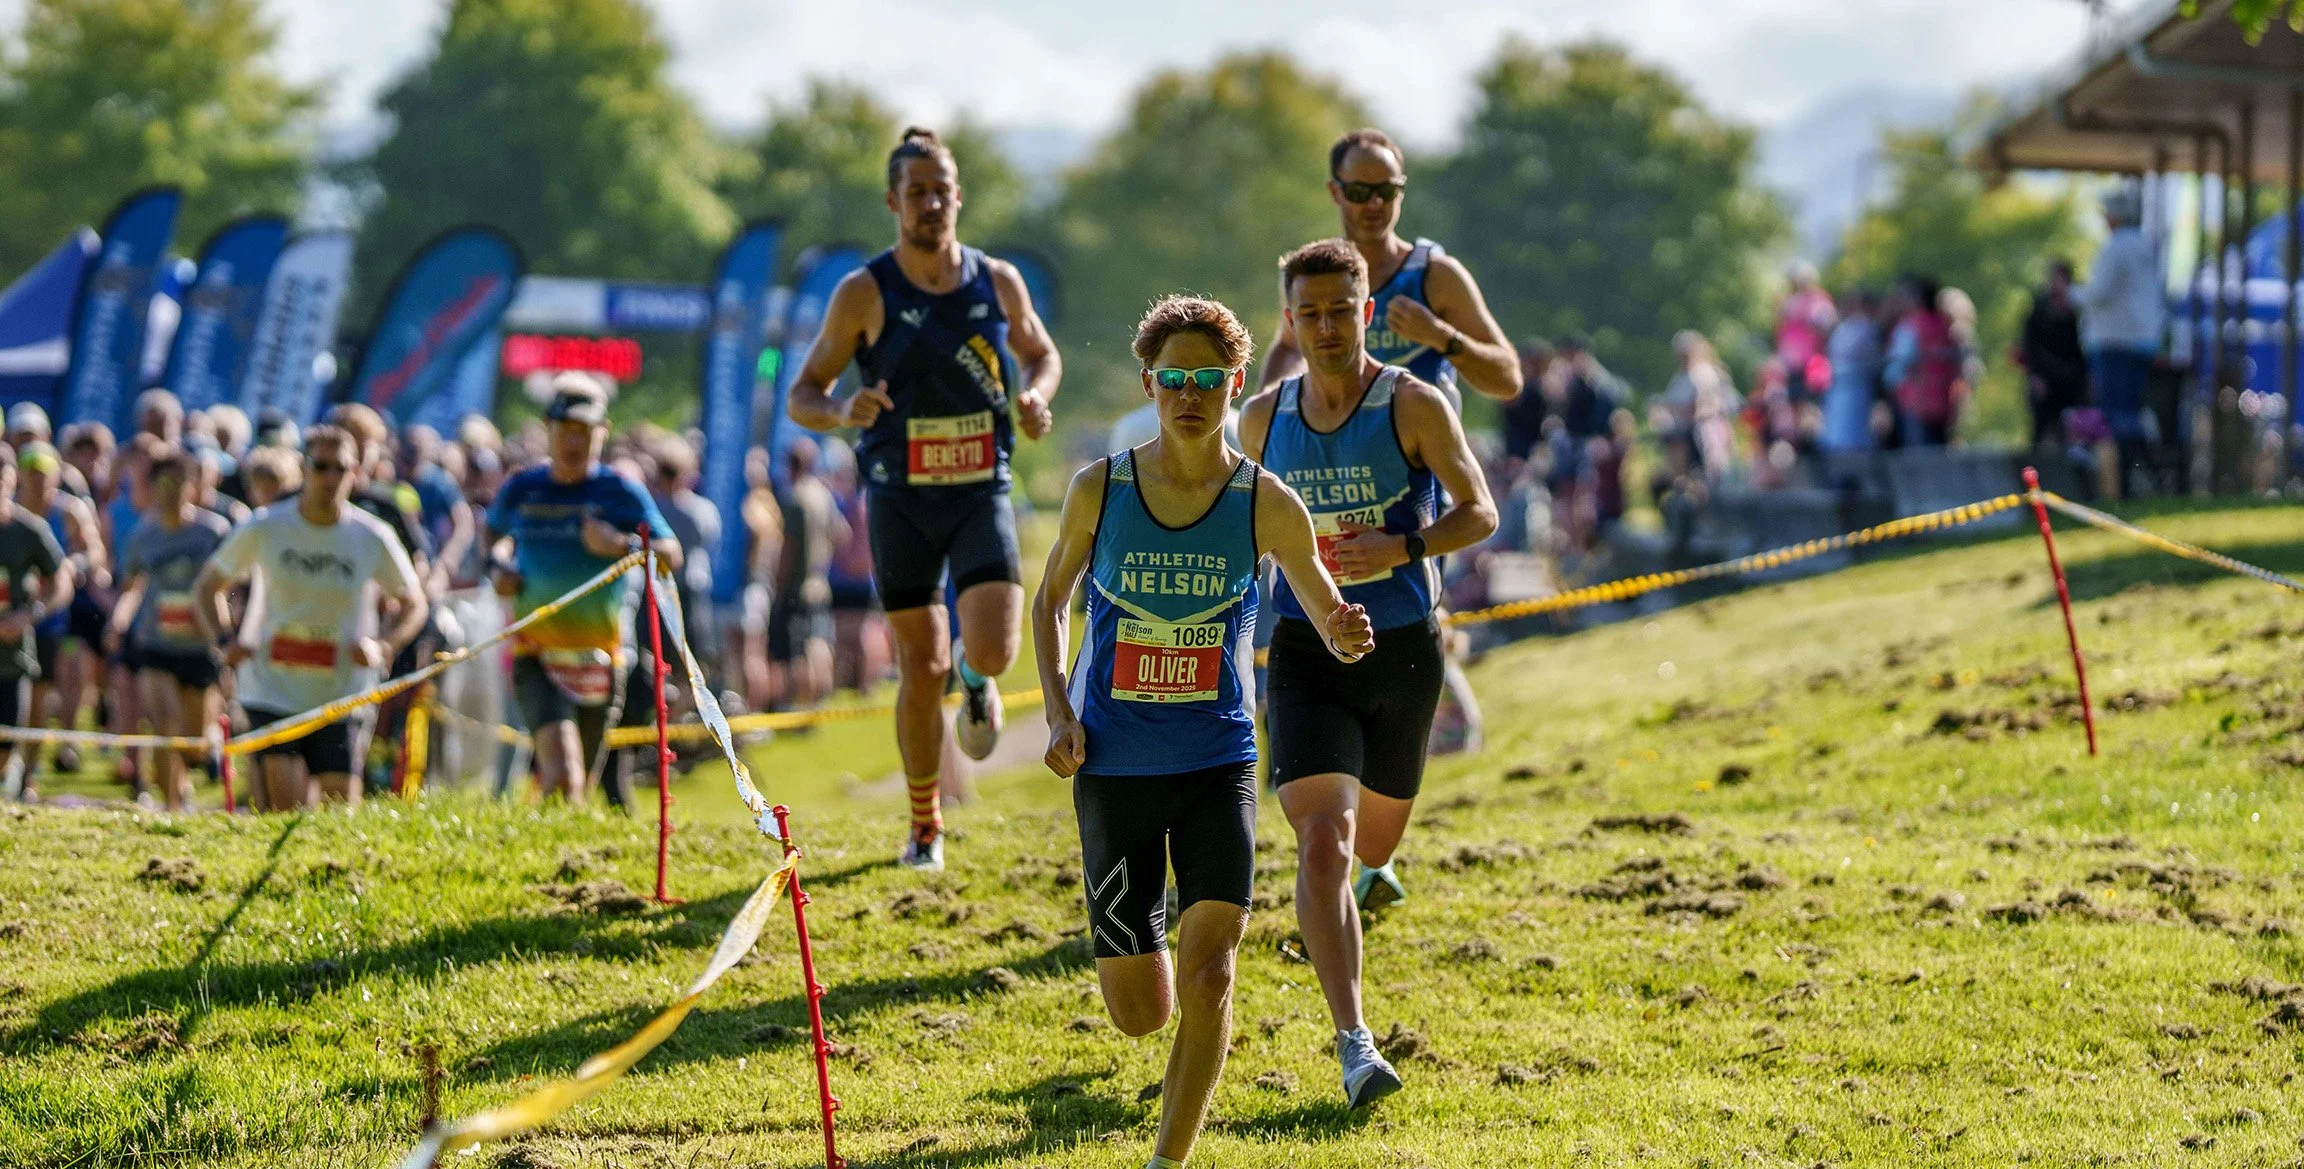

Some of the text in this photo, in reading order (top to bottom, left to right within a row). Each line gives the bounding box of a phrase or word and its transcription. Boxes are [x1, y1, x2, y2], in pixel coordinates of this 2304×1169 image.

[922, 440, 984, 468] BENEYTO
[1285, 466, 1372, 483] ATHLETICS
[1297, 482, 1378, 507] ELSON
[1123, 551, 1227, 570] ATHLETICS
[1121, 571, 1226, 597] NELSON
[1172, 626, 1219, 647] 1089
[1138, 654, 1198, 684] OLIVER
[1181, 684, 1196, 692] 2025
